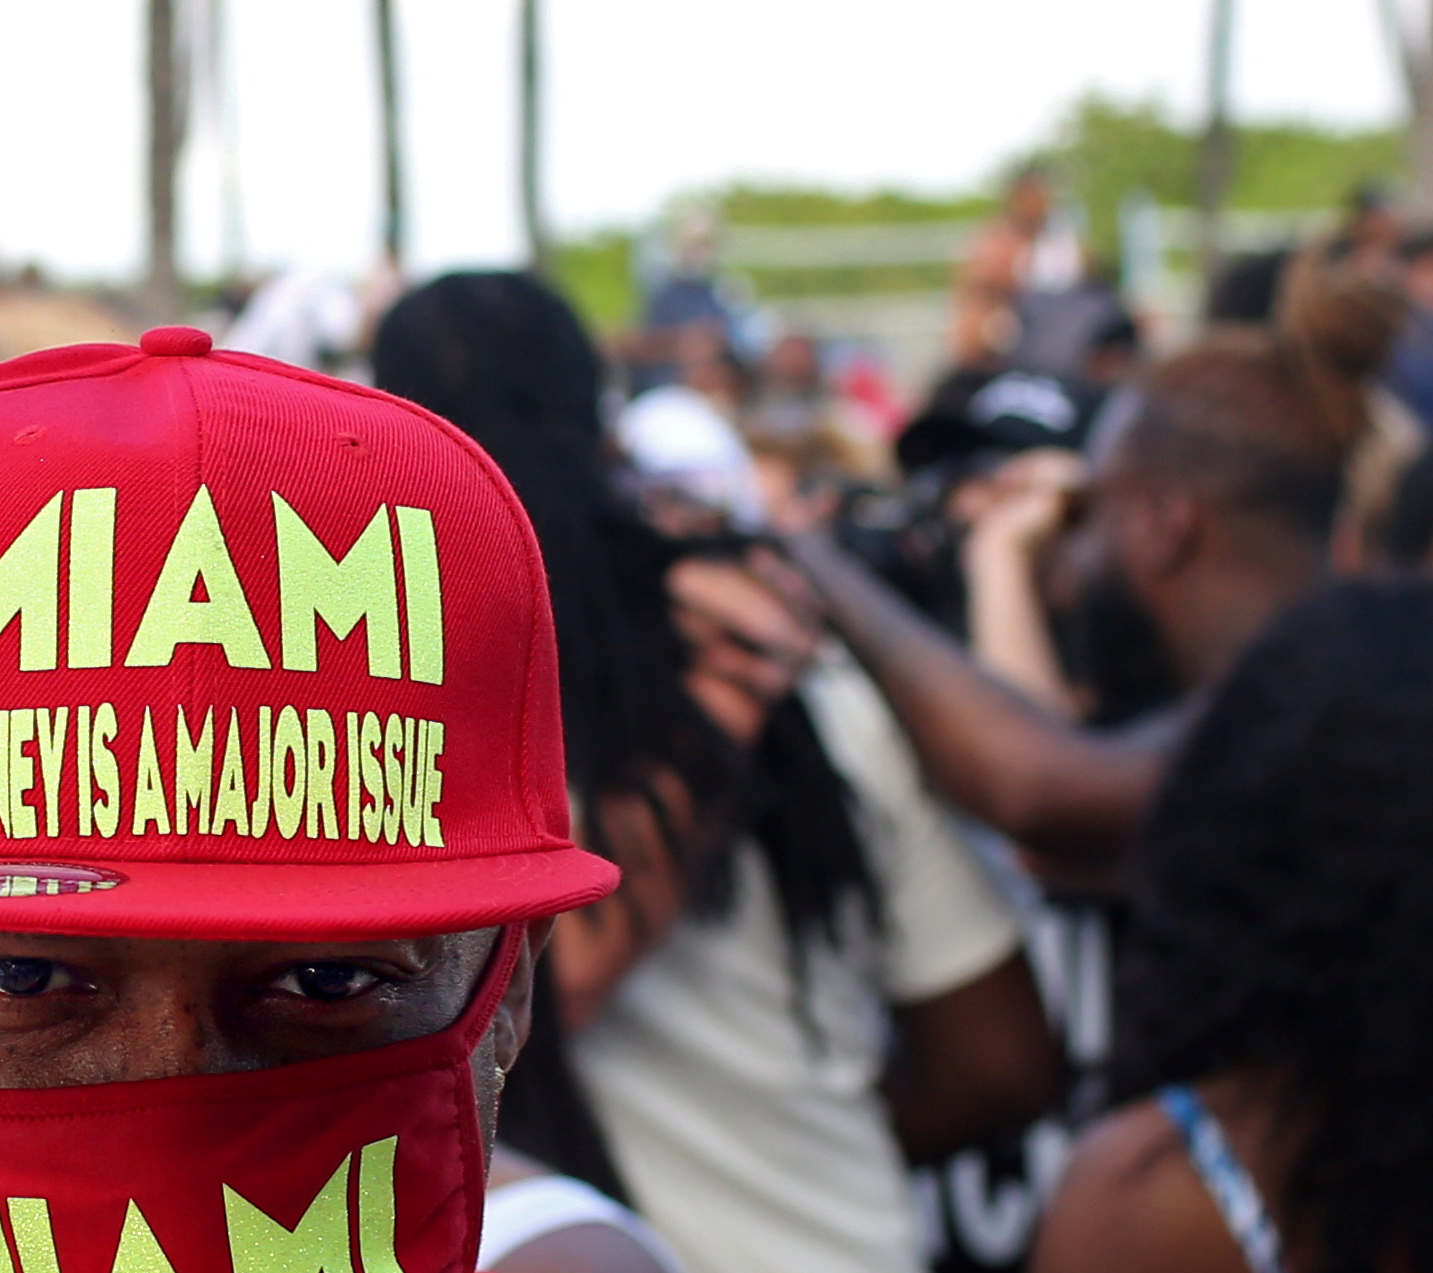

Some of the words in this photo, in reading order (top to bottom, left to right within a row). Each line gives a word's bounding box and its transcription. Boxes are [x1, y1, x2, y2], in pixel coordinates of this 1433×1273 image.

[77, 702, 122, 839] IS
[132, 705, 171, 836] A
[175, 703, 339, 840] MAJOR
[346, 710, 446, 848] ISSUE
